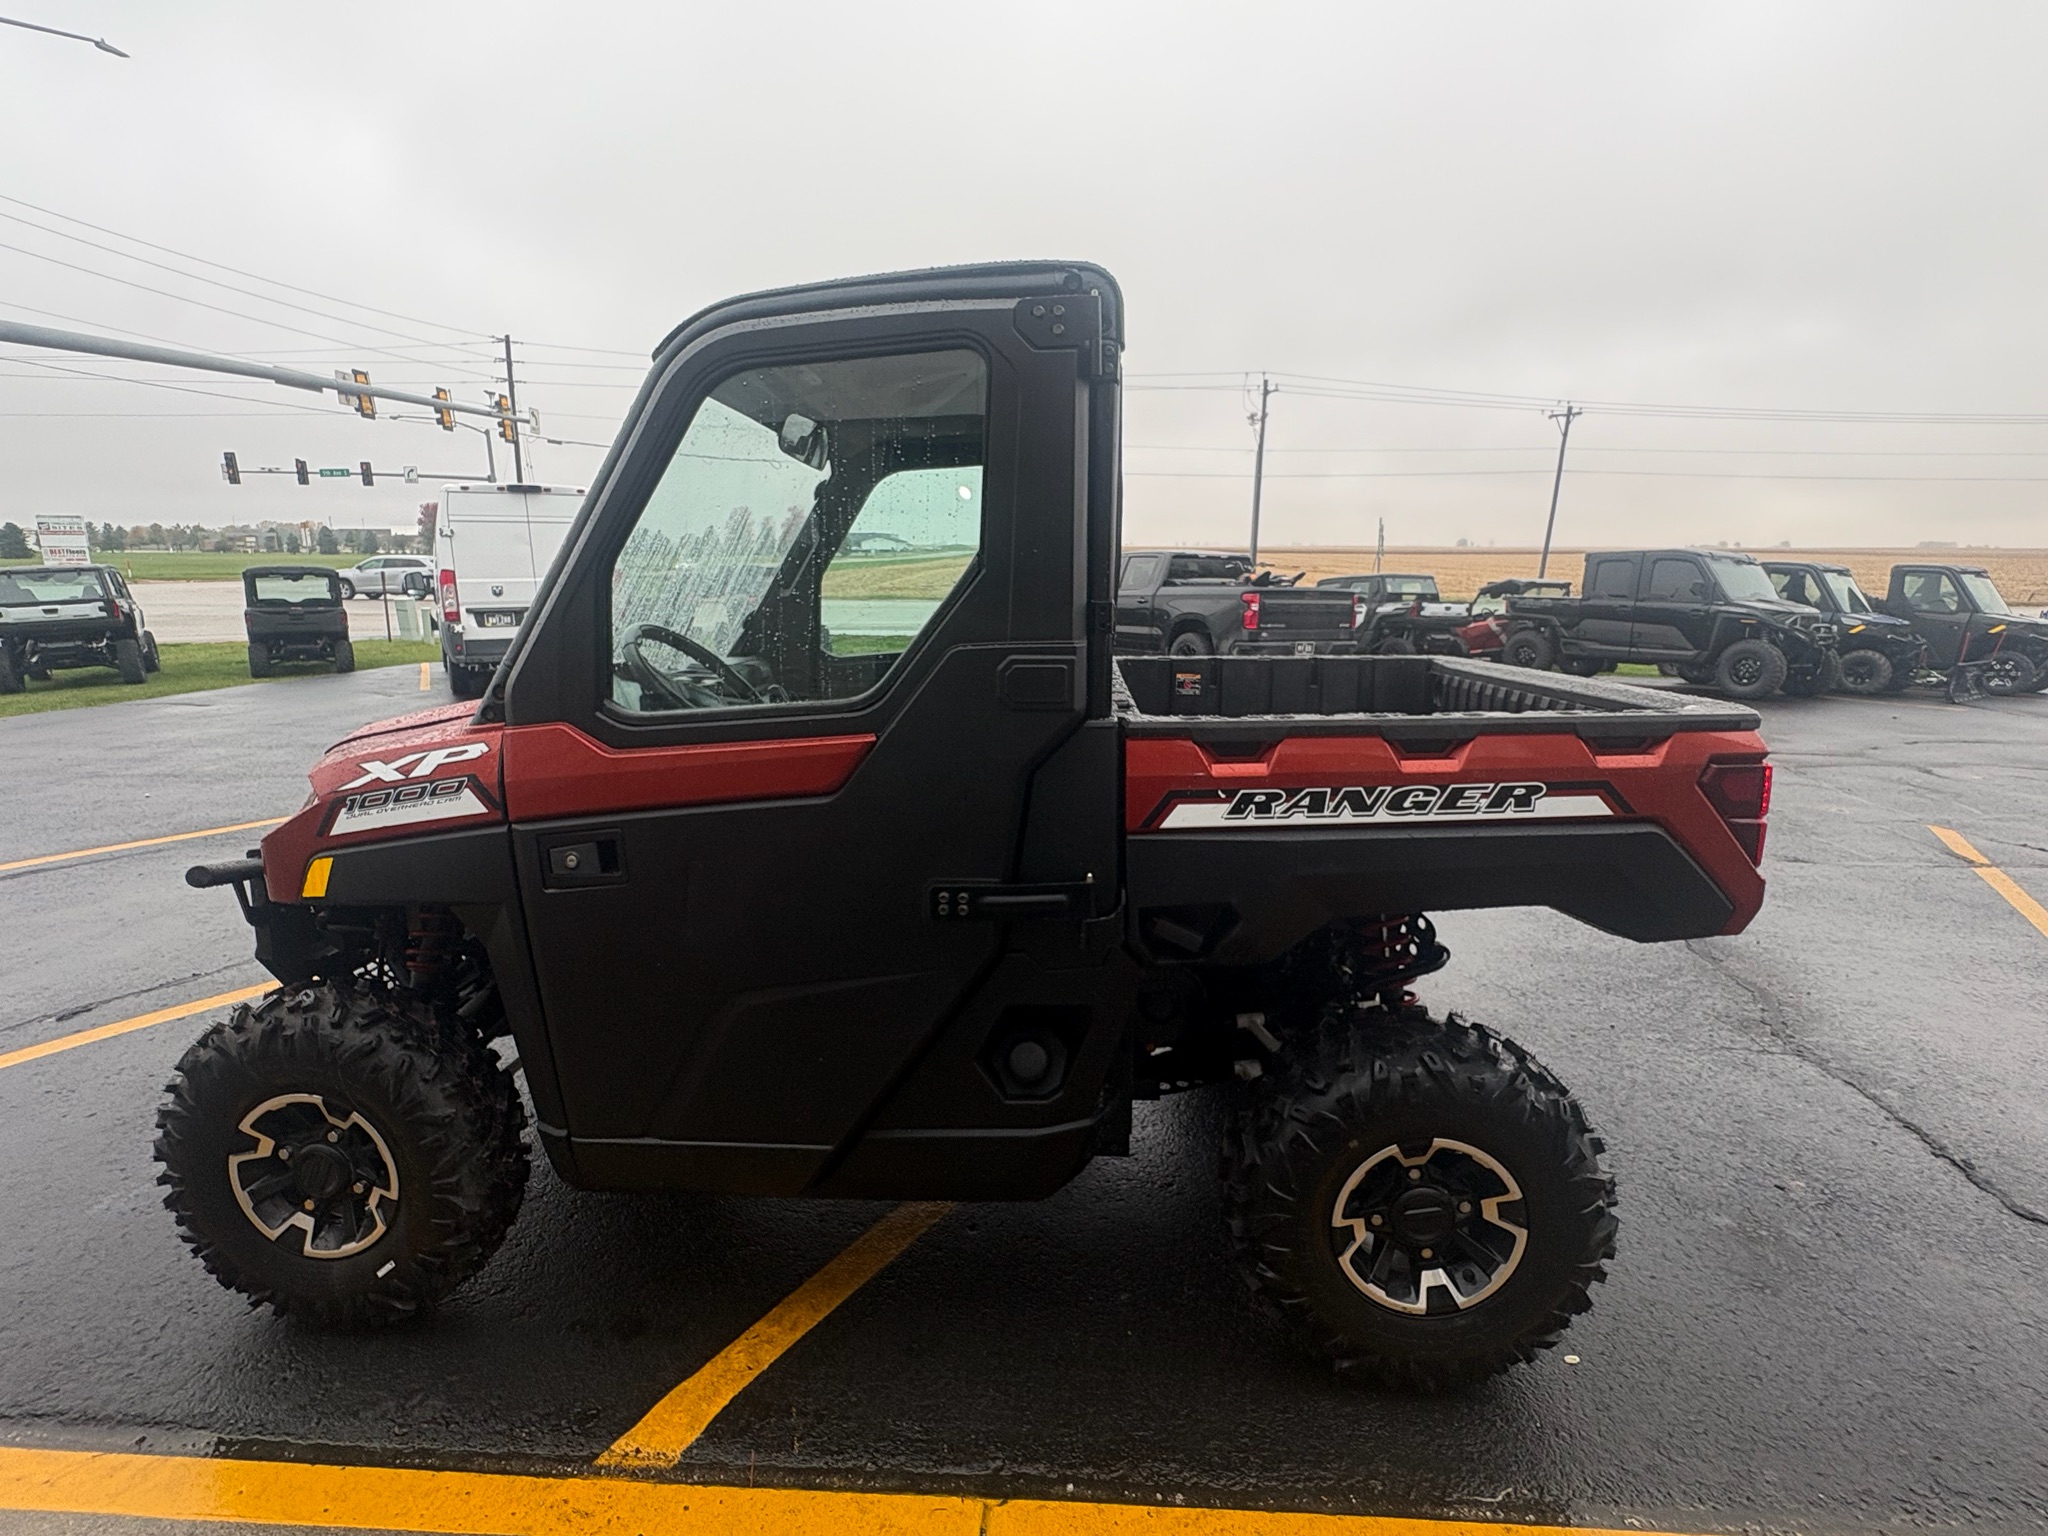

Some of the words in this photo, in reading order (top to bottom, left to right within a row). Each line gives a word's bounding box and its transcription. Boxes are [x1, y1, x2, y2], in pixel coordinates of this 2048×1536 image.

[338, 743, 489, 790] XP
[344, 777, 468, 814] 1000
[346, 811, 373, 819] DUAL
[376, 801, 434, 814] OVERHEAD
[437, 796, 462, 805] CAM
[1221, 782, 1547, 819] RANGER
